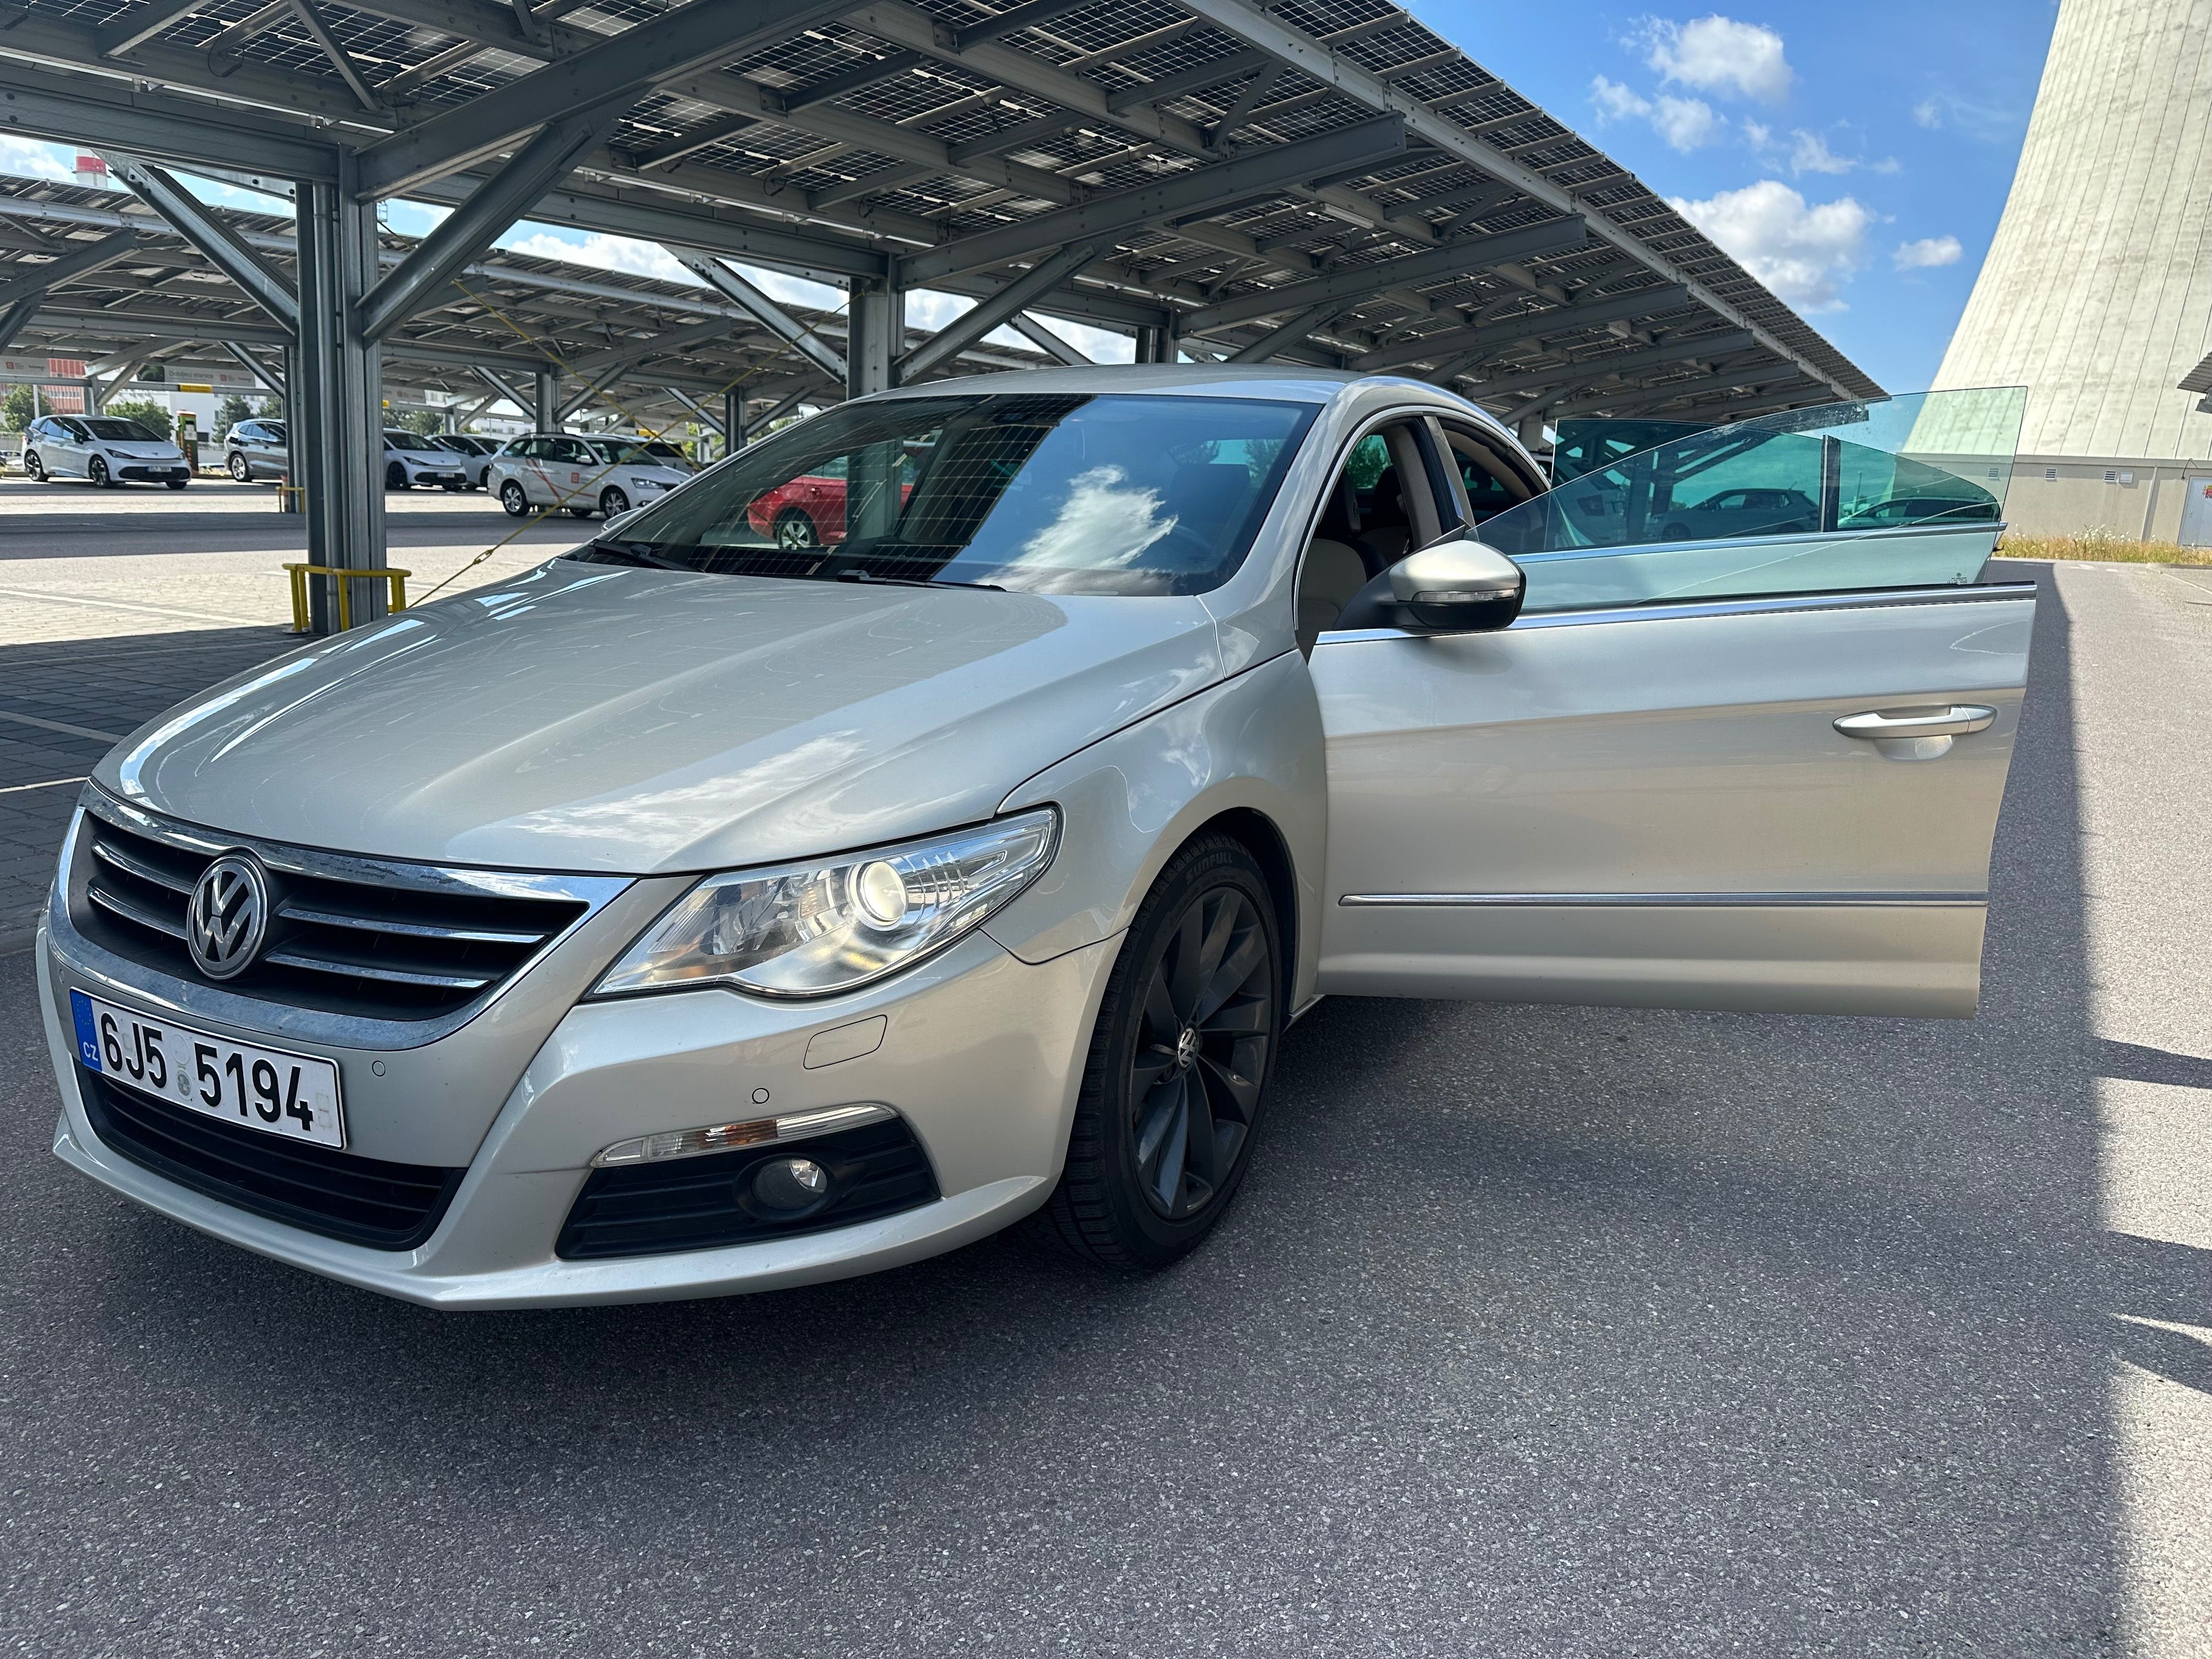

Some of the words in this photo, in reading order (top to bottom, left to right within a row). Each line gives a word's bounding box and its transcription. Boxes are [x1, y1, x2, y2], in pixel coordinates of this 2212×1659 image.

[83, 1041, 99, 1061] CZ
[101, 1012, 167, 1088] 6J5
[195, 1042, 313, 1131] 5194
